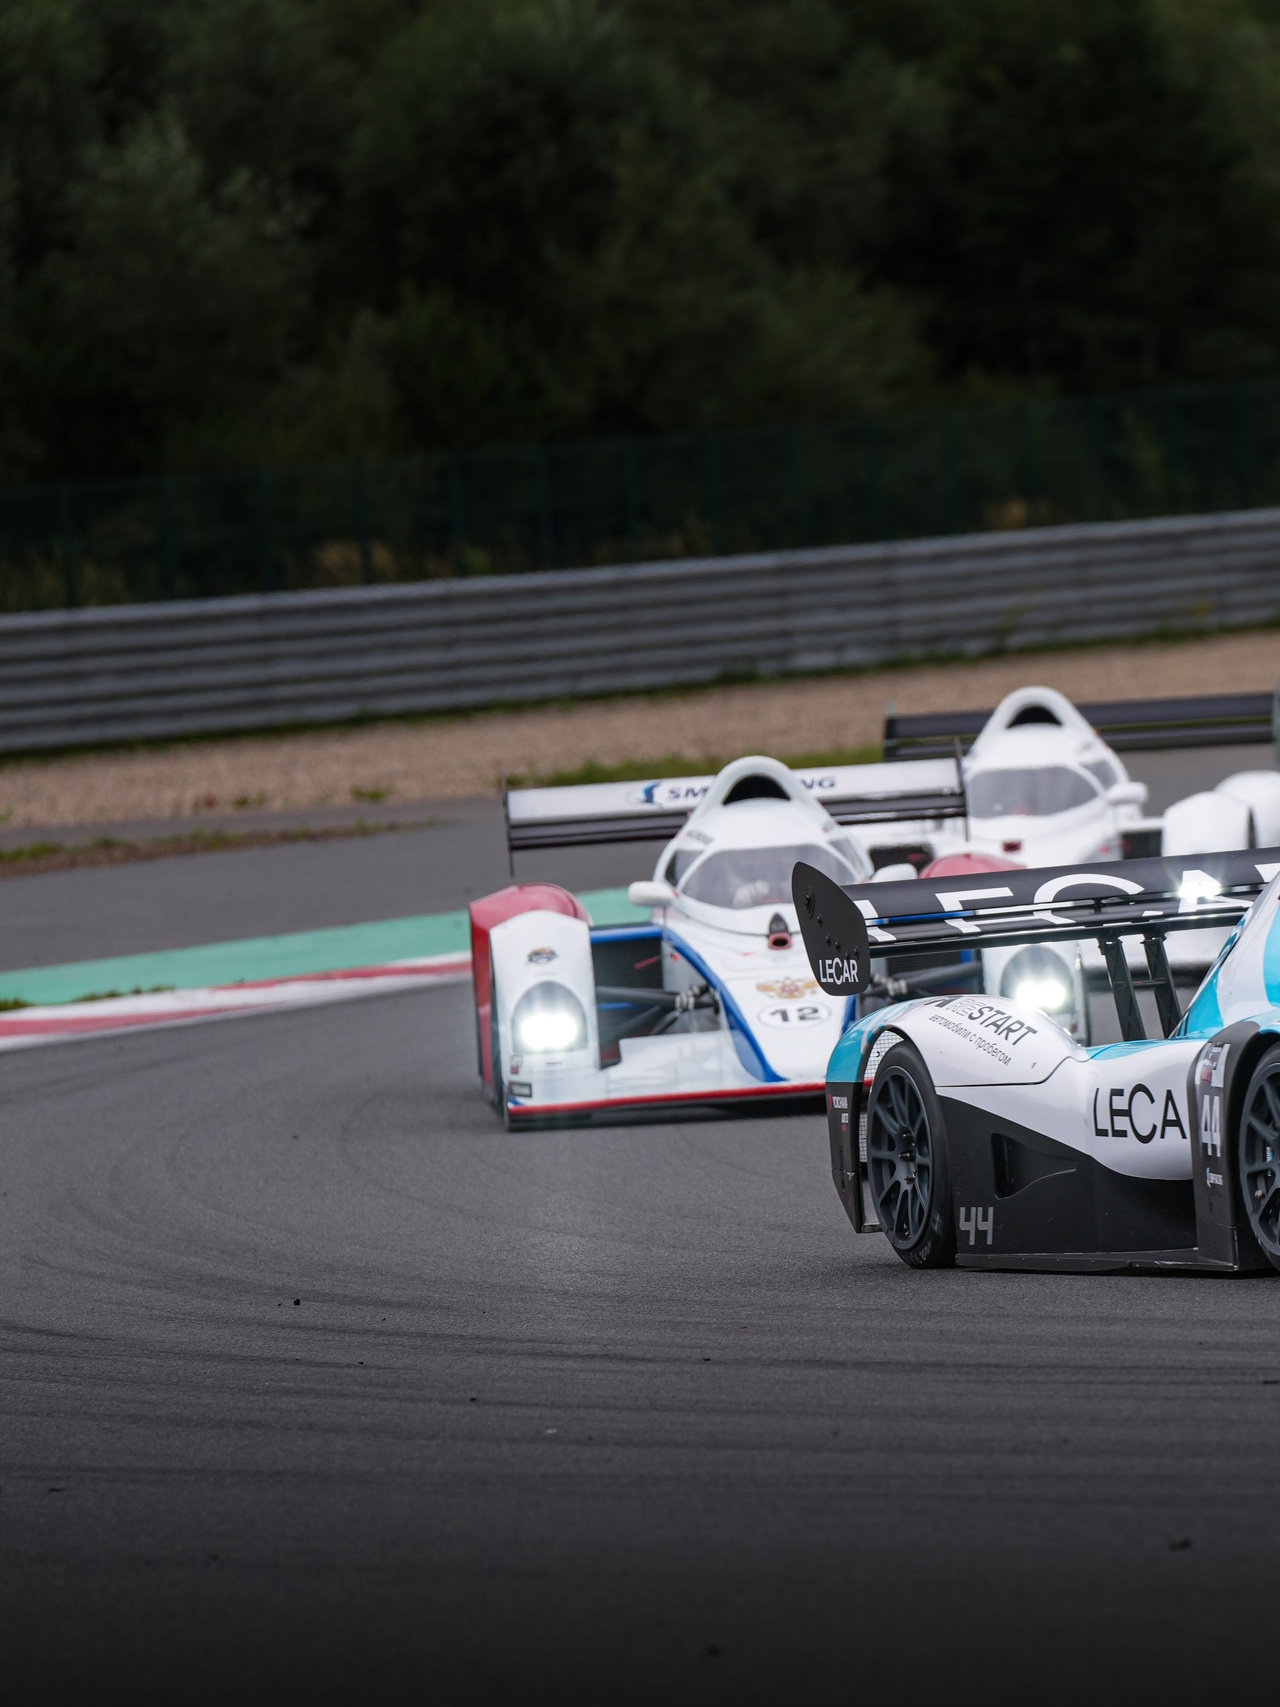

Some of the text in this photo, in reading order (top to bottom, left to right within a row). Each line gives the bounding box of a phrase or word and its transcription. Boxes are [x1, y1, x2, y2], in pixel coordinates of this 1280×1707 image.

[669, 784, 711, 799] SM
[818, 957, 859, 985] LECAR
[770, 1006, 820, 1022] 12
[928, 1014, 1012, 1066] автомобили с пробегом
[1093, 1083, 1188, 1144] LECA
[1202, 1094, 1221, 1157] 44
[958, 1206, 994, 1246] 44
